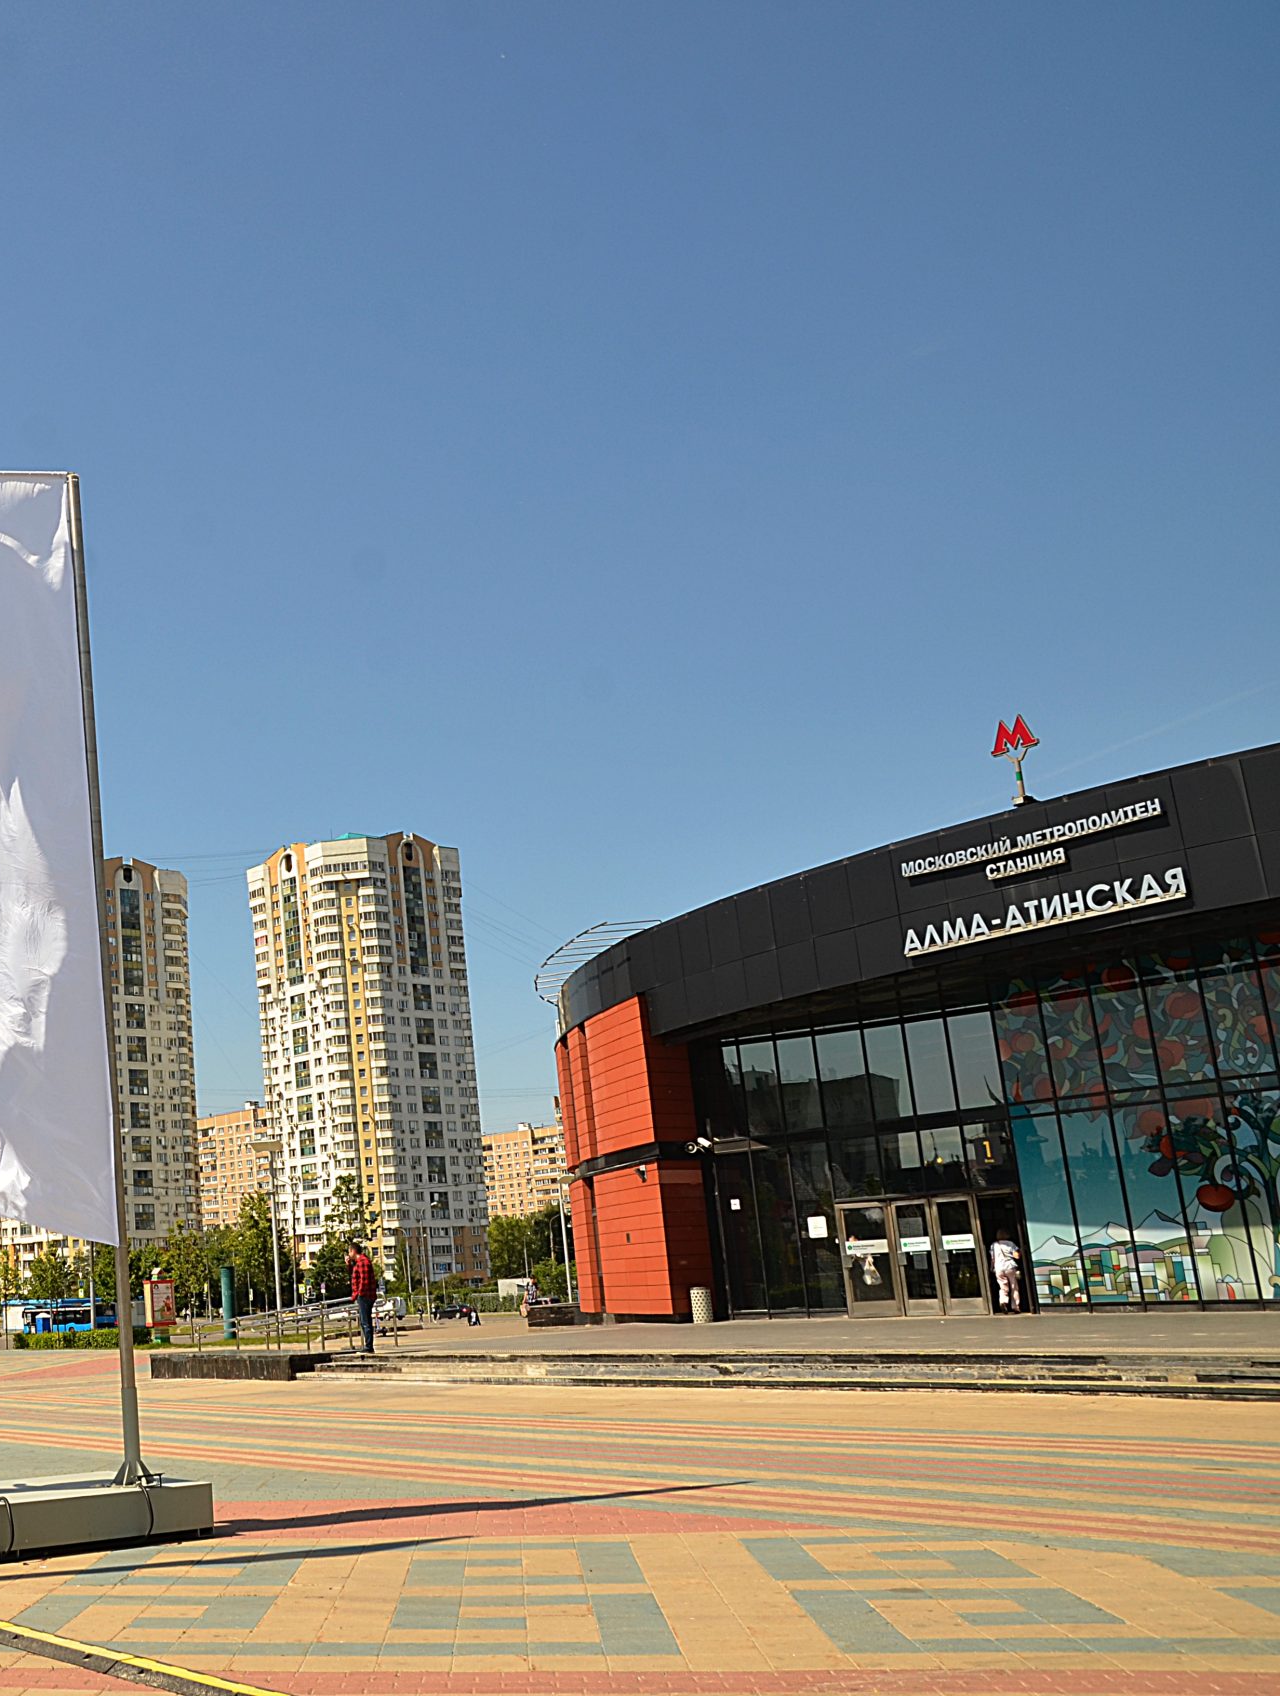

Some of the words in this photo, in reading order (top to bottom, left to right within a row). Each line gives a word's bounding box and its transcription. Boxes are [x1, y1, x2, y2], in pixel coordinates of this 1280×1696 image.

[991, 713, 1039, 757] М
[901, 837, 1012, 877] МОСКОВСКИЙ
[1016, 798, 1162, 850] МЕТРОПОЛИТЕН
[985, 847, 1066, 880] СТАНЦИЯ
[903, 866, 1187, 955] АЛМА-АТИНСКАЯ
[982, 1140, 992, 1158] 1
